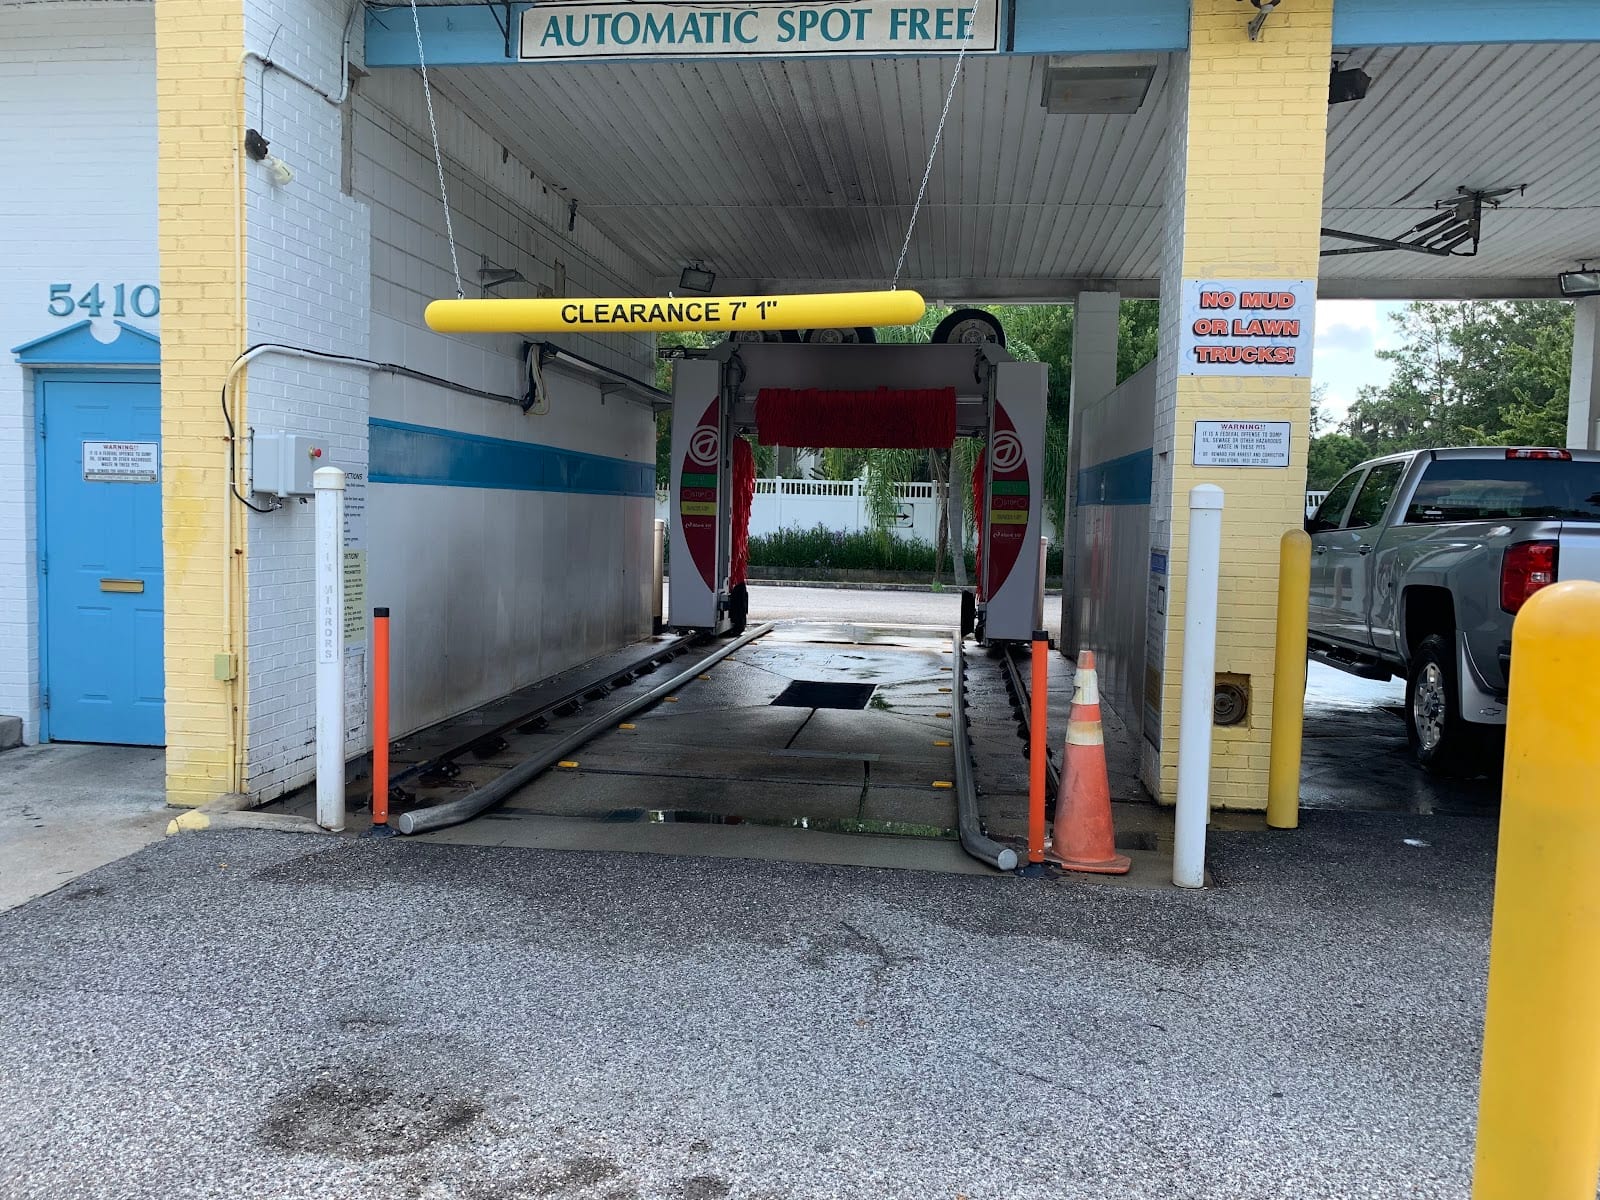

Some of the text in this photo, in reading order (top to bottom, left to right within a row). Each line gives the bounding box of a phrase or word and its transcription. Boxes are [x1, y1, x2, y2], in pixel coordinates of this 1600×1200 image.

[540, 8, 975, 47] AUTOMATIC SPOT FREE
[48, 283, 160, 318] 5410
[1201, 291, 1296, 310] NO MUD
[561, 302, 721, 324] CLEARANCE
[729, 302, 747, 321] 7'
[1193, 318, 1300, 338] OR LAWN
[1194, 346, 1296, 365] TRUCKS!
[323, 584, 334, 660] MIRRORS
